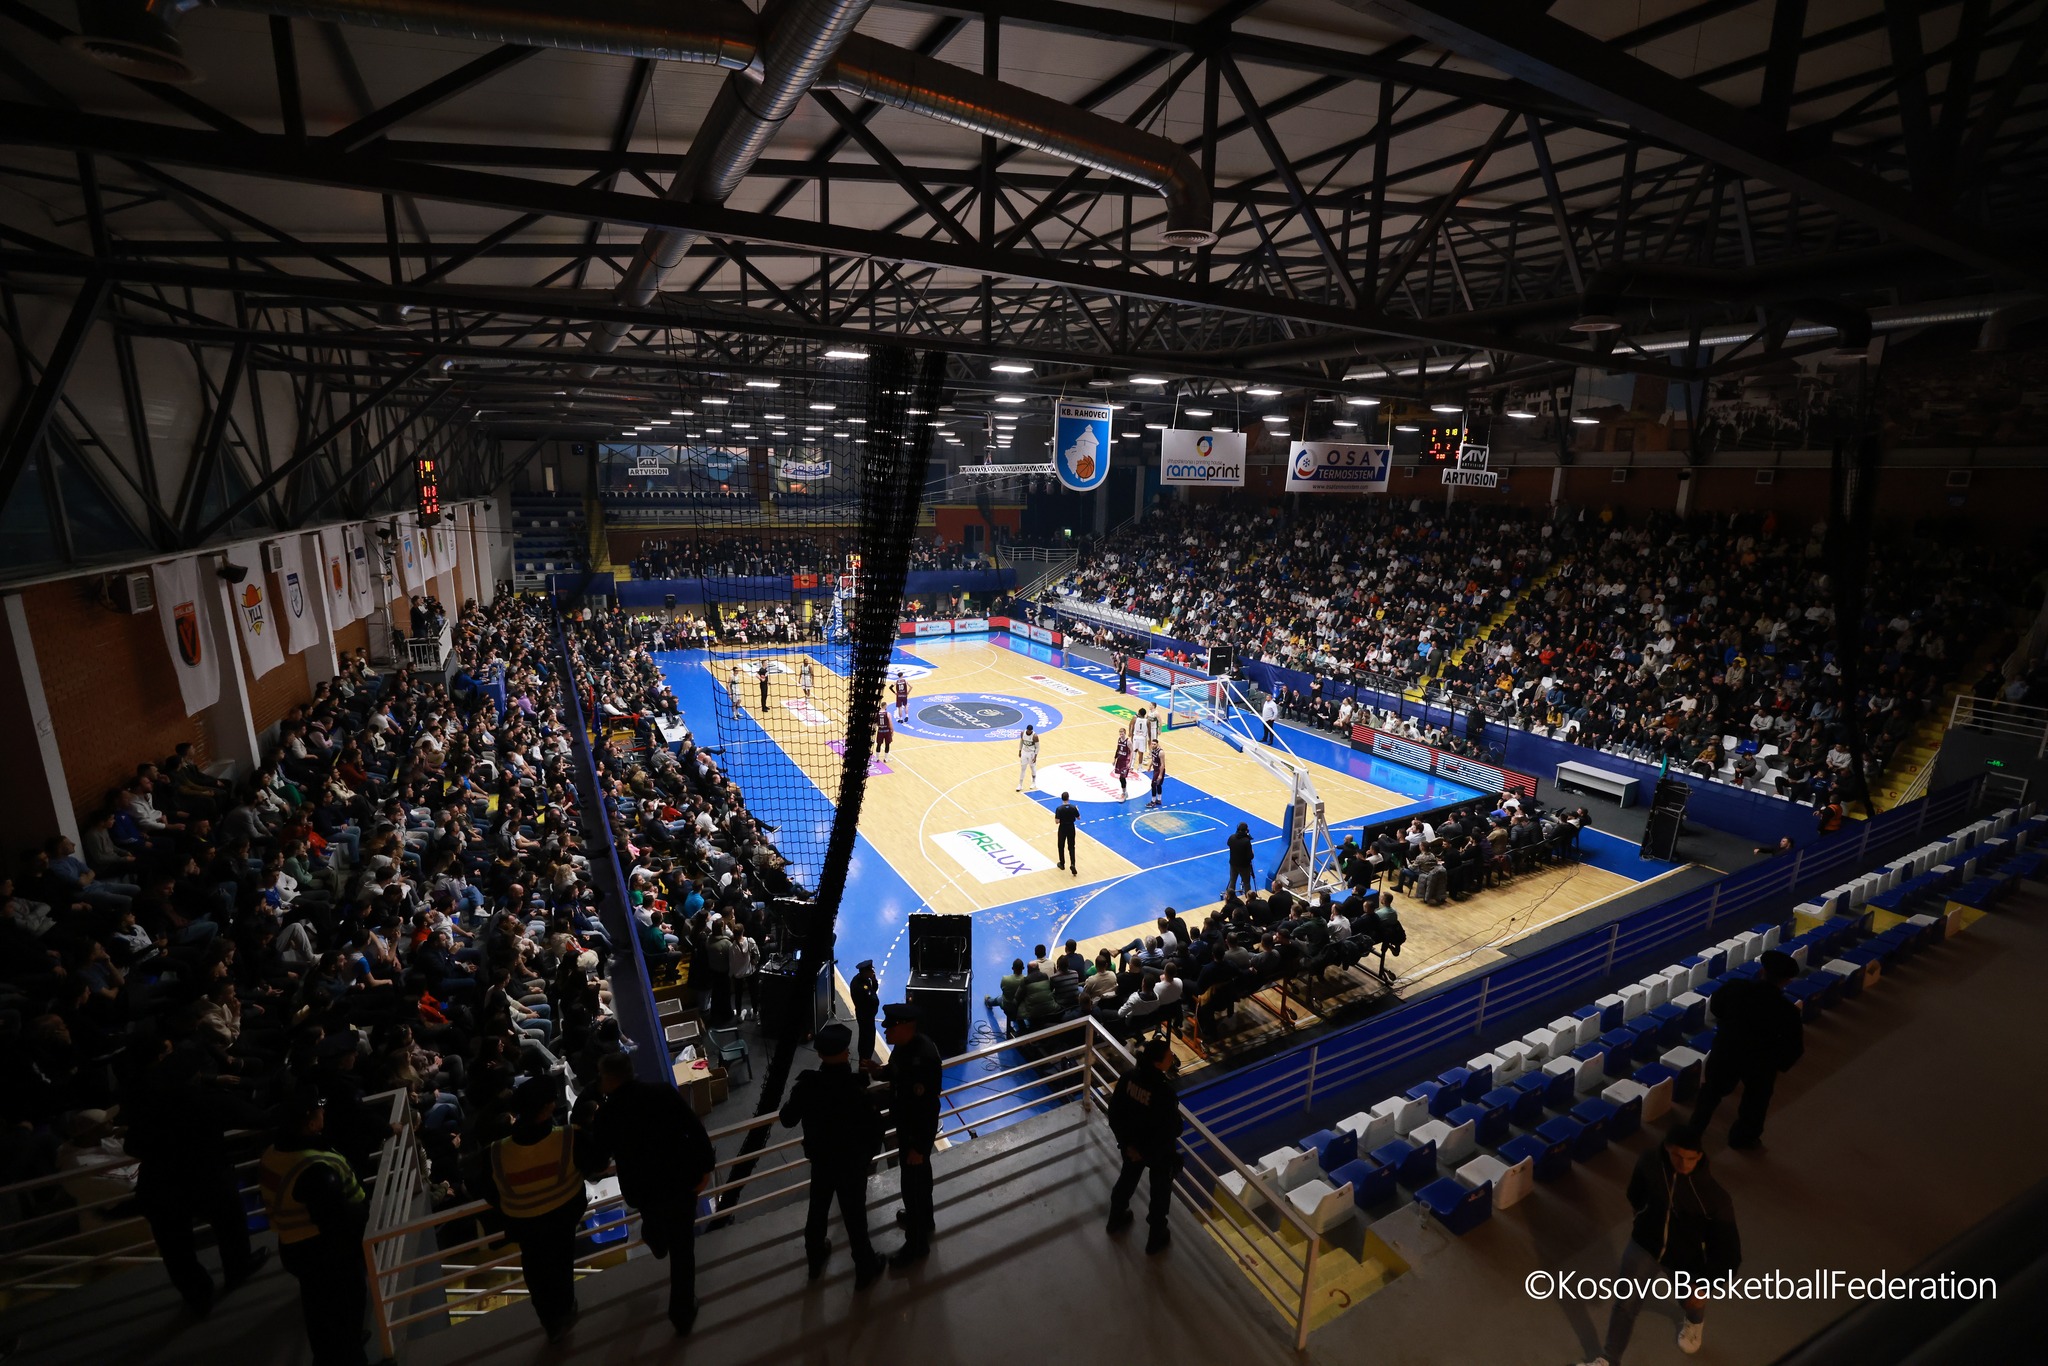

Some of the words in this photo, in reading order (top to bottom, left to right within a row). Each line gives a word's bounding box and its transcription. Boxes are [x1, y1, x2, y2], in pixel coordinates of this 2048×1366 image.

[1061, 408, 1073, 416] KB.
[1075, 409, 1108, 419] RAHOVECI
[1326, 450, 1370, 465] OSA
[1166, 463, 1240, 481] ramaprint
[1318, 468, 1374, 480] TERMOSISTEM
[1444, 471, 1496, 487] ARTVISION
